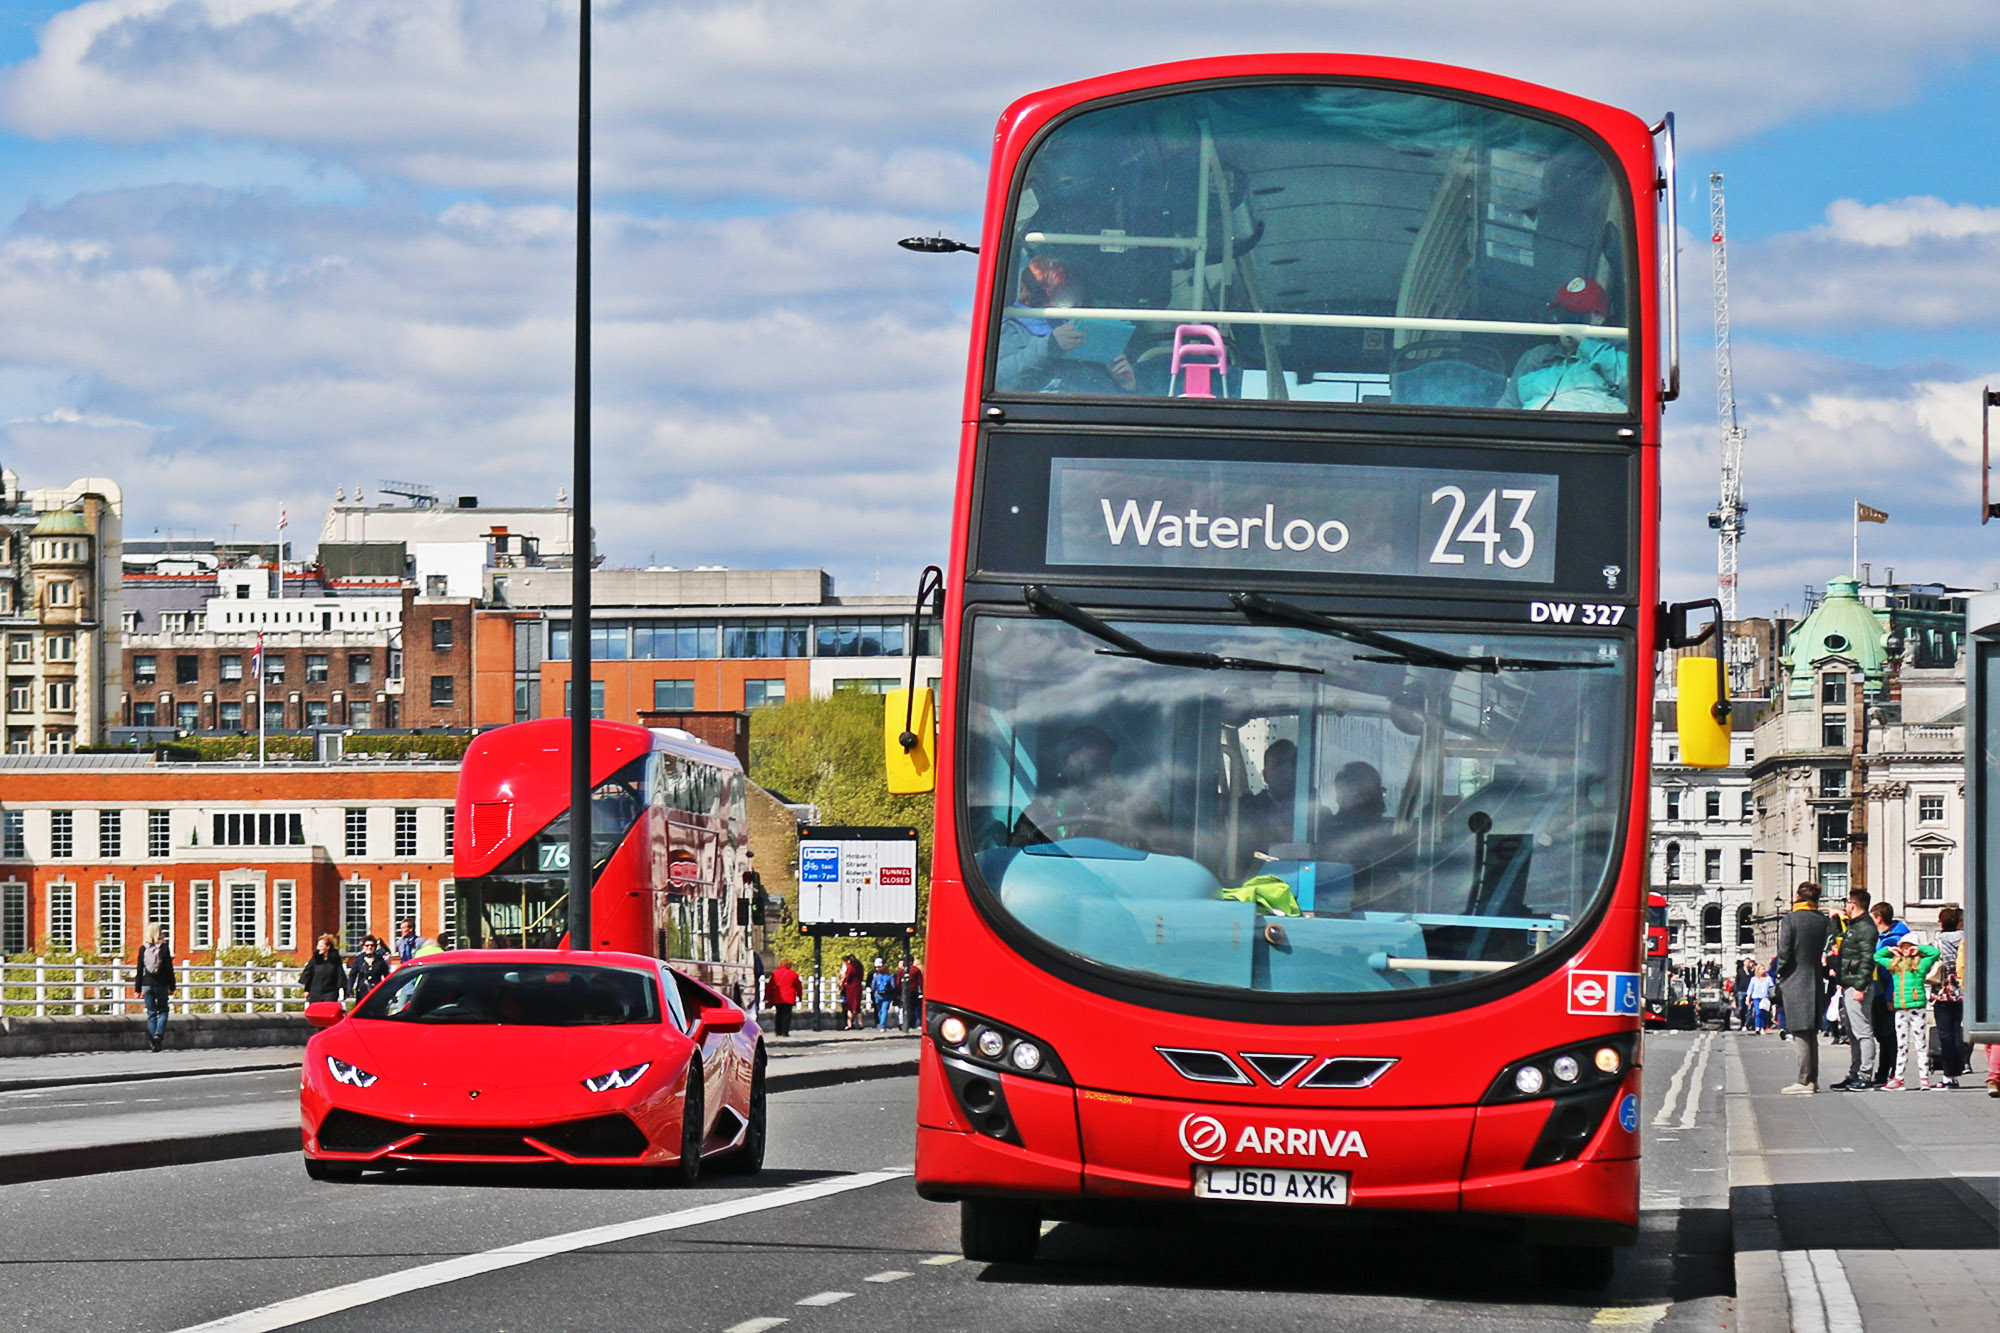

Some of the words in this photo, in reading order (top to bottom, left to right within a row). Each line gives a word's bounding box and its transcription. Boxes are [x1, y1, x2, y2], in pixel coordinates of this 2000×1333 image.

[1100, 498, 1350, 553] Waterloo
[1429, 484, 1537, 569] 243
[1530, 602, 1576, 624] DW
[1581, 603, 1626, 626] 327
[541, 845, 570, 868] 76
[881, 868, 911, 876] TUNNEL
[881, 876, 910, 884] CLOSED
[1235, 1126, 1368, 1159] ARRIVA
[1206, 1171, 1276, 1197] LJ60
[1284, 1174, 1337, 1199] AXK
